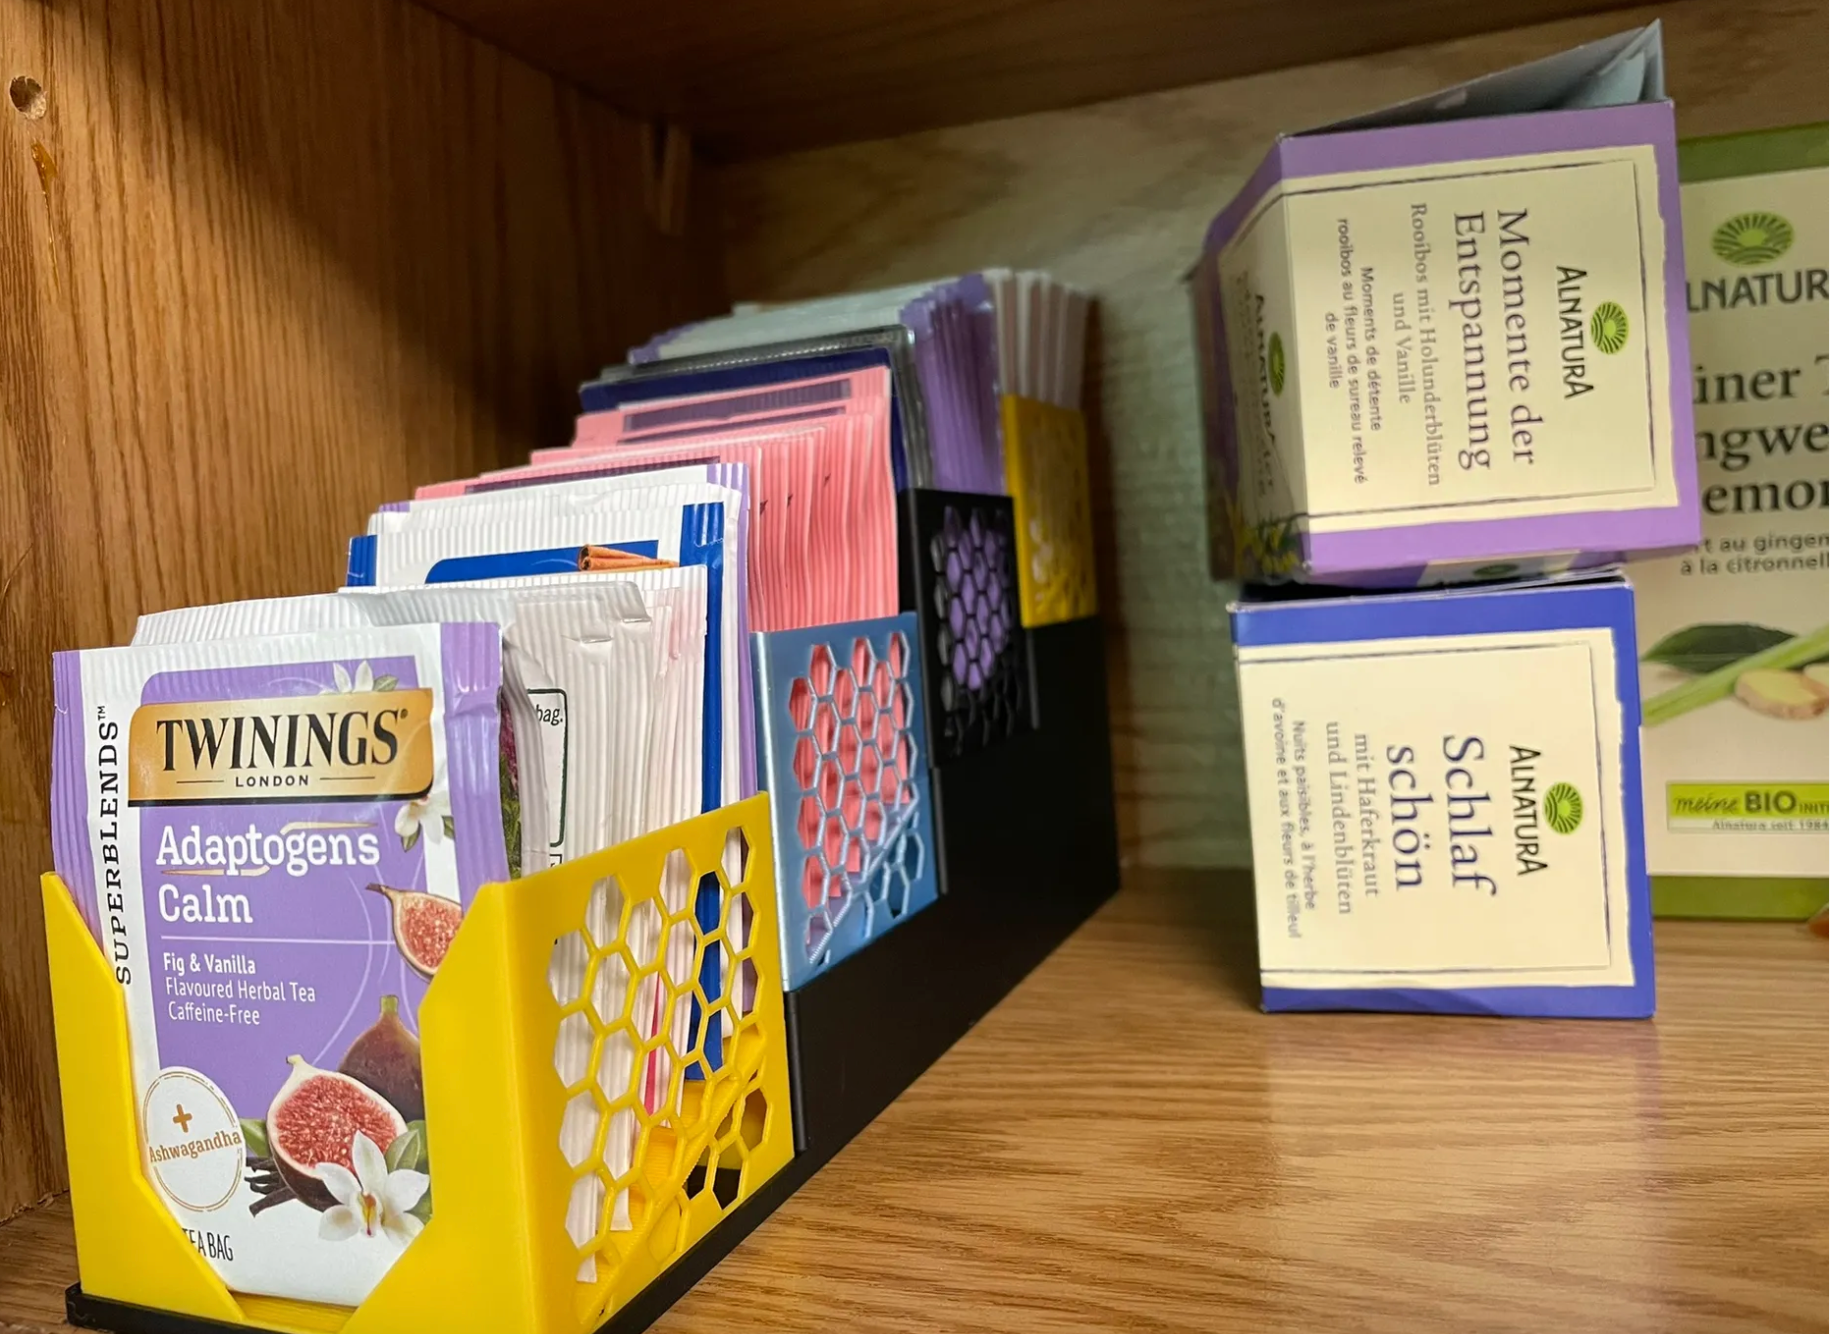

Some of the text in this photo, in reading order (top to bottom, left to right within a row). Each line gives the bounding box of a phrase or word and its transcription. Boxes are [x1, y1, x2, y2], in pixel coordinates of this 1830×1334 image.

[1685, 268, 1828, 313] LNATUR
[1324, 311, 1343, 389] de vanille
[1337, 217, 1369, 485] rooibos au fleurs de sureau relevé
[1360, 266, 1382, 432] Moments de détente
[1392, 292, 1416, 404] und Vanille
[1410, 202, 1444, 486] Rooibos mit Holunderblüten
[1448, 210, 1491, 471] Entspannung
[1497, 207, 1544, 466] Momente der
[1555, 265, 1595, 400] ALNATURA
[1692, 363, 1801, 404] iner
[1695, 422, 1828, 473] ngwe
[1701, 479, 1828, 516] emo
[1680, 560, 1692, 576] à
[1700, 558, 1718, 575] la
[1719, 537, 1746, 552] au
[1292, 719, 1308, 762] Nuits
[235, 774, 309, 788] LONDON
[1277, 768, 1288, 785] et
[1278, 789, 1290, 818] aux
[1293, 764, 1313, 838] paisibles,
[1325, 721, 1355, 915] und Lindenblüten
[1354, 732, 1381, 897] mit Haferkraut
[1385, 744, 1435, 893] schön
[1442, 734, 1498, 897] Schlaf
[1508, 744, 1549, 877] ALNATURA
[1674, 791, 1740, 815] meine
[1744, 789, 1797, 814] BIO
[155, 825, 381, 877] Adaptogens
[1281, 820, 1296, 866] fleurs
[1301, 841, 1312, 852] à
[1284, 869, 1297, 889] de
[158, 884, 254, 924] Calm
[1286, 892, 1302, 938] tilleul
[163, 952, 257, 977] Fig & Vanilla
[165, 976, 316, 1002] Flavoured Herbal Tea
[168, 1000, 260, 1025] Caffeine-Free
[148, 1129, 242, 1163] Ashwagandha
[206, 1231, 234, 1262] BAG
